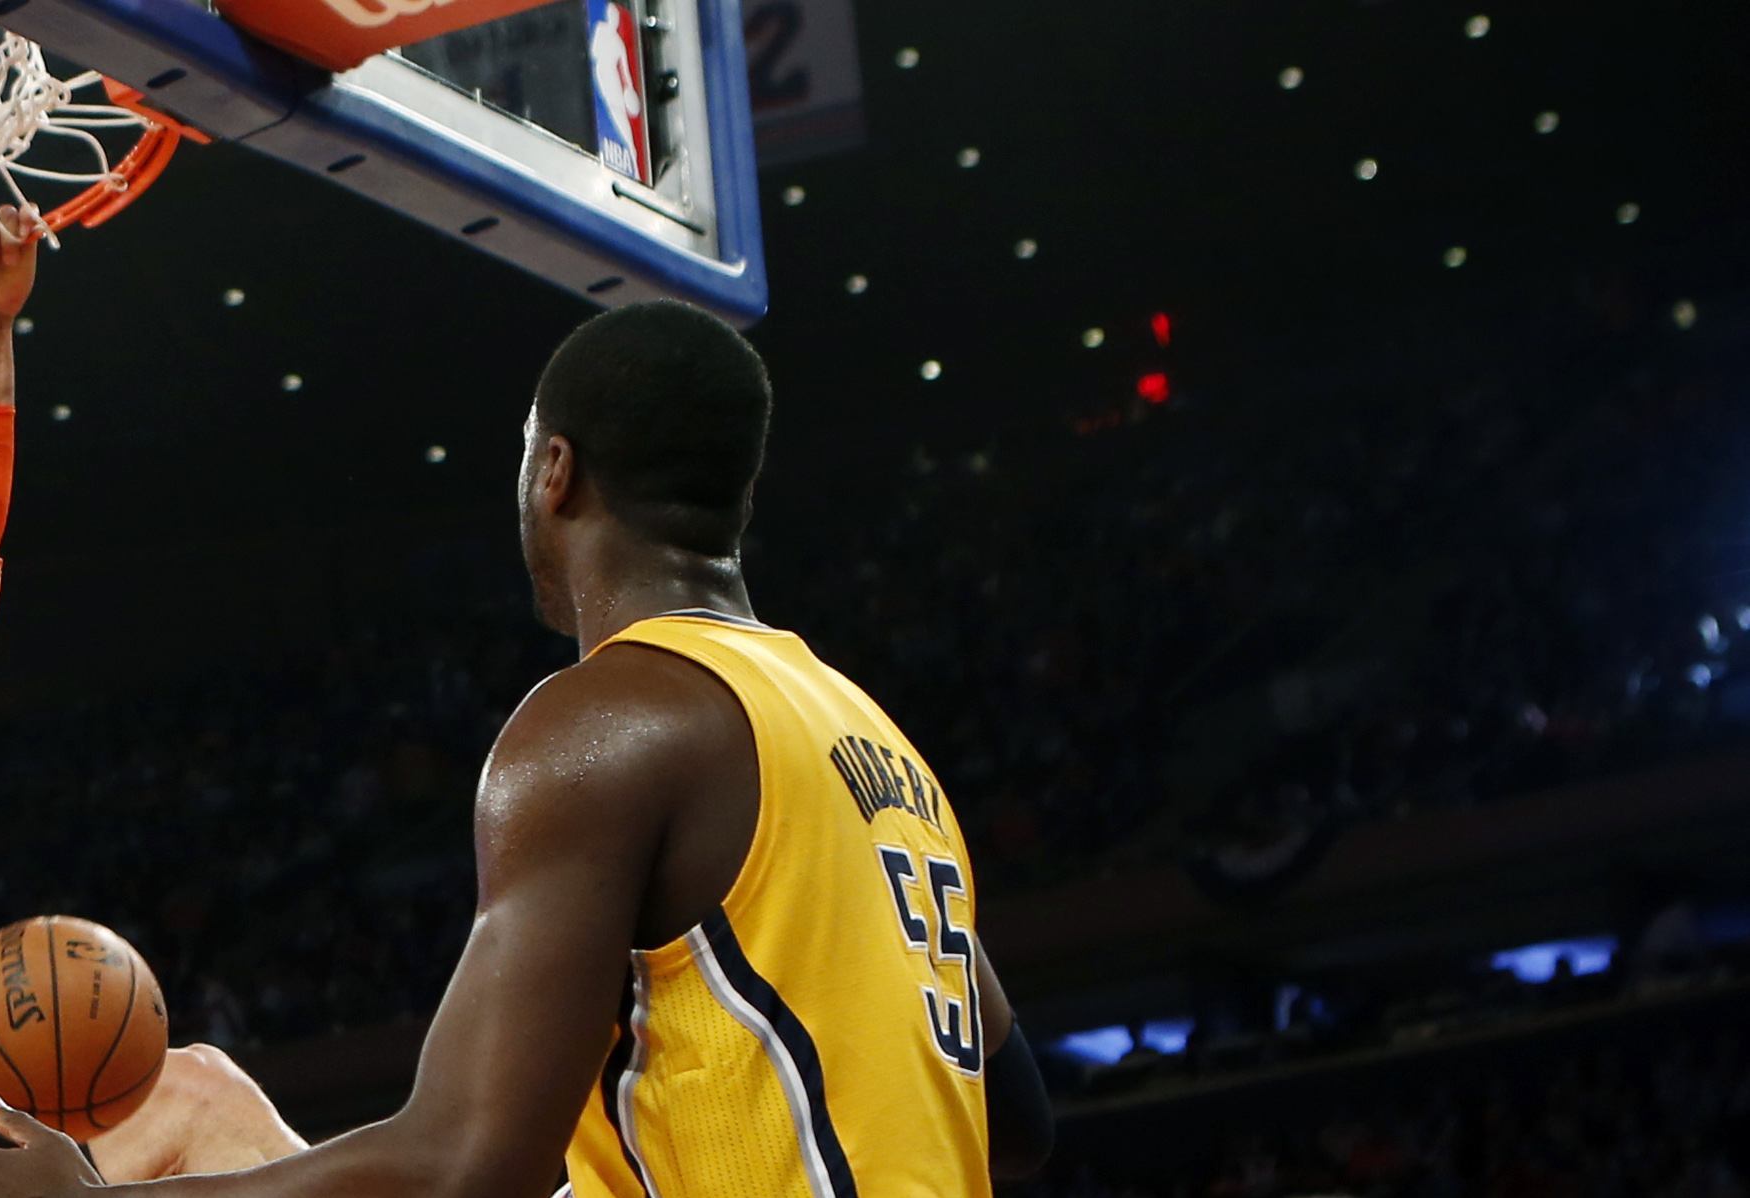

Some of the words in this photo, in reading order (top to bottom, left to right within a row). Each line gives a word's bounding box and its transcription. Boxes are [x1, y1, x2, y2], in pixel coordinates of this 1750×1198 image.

[603, 136, 634, 176] NBA
[0, 922, 46, 1031] SPALD
[877, 843, 984, 1078] 55
